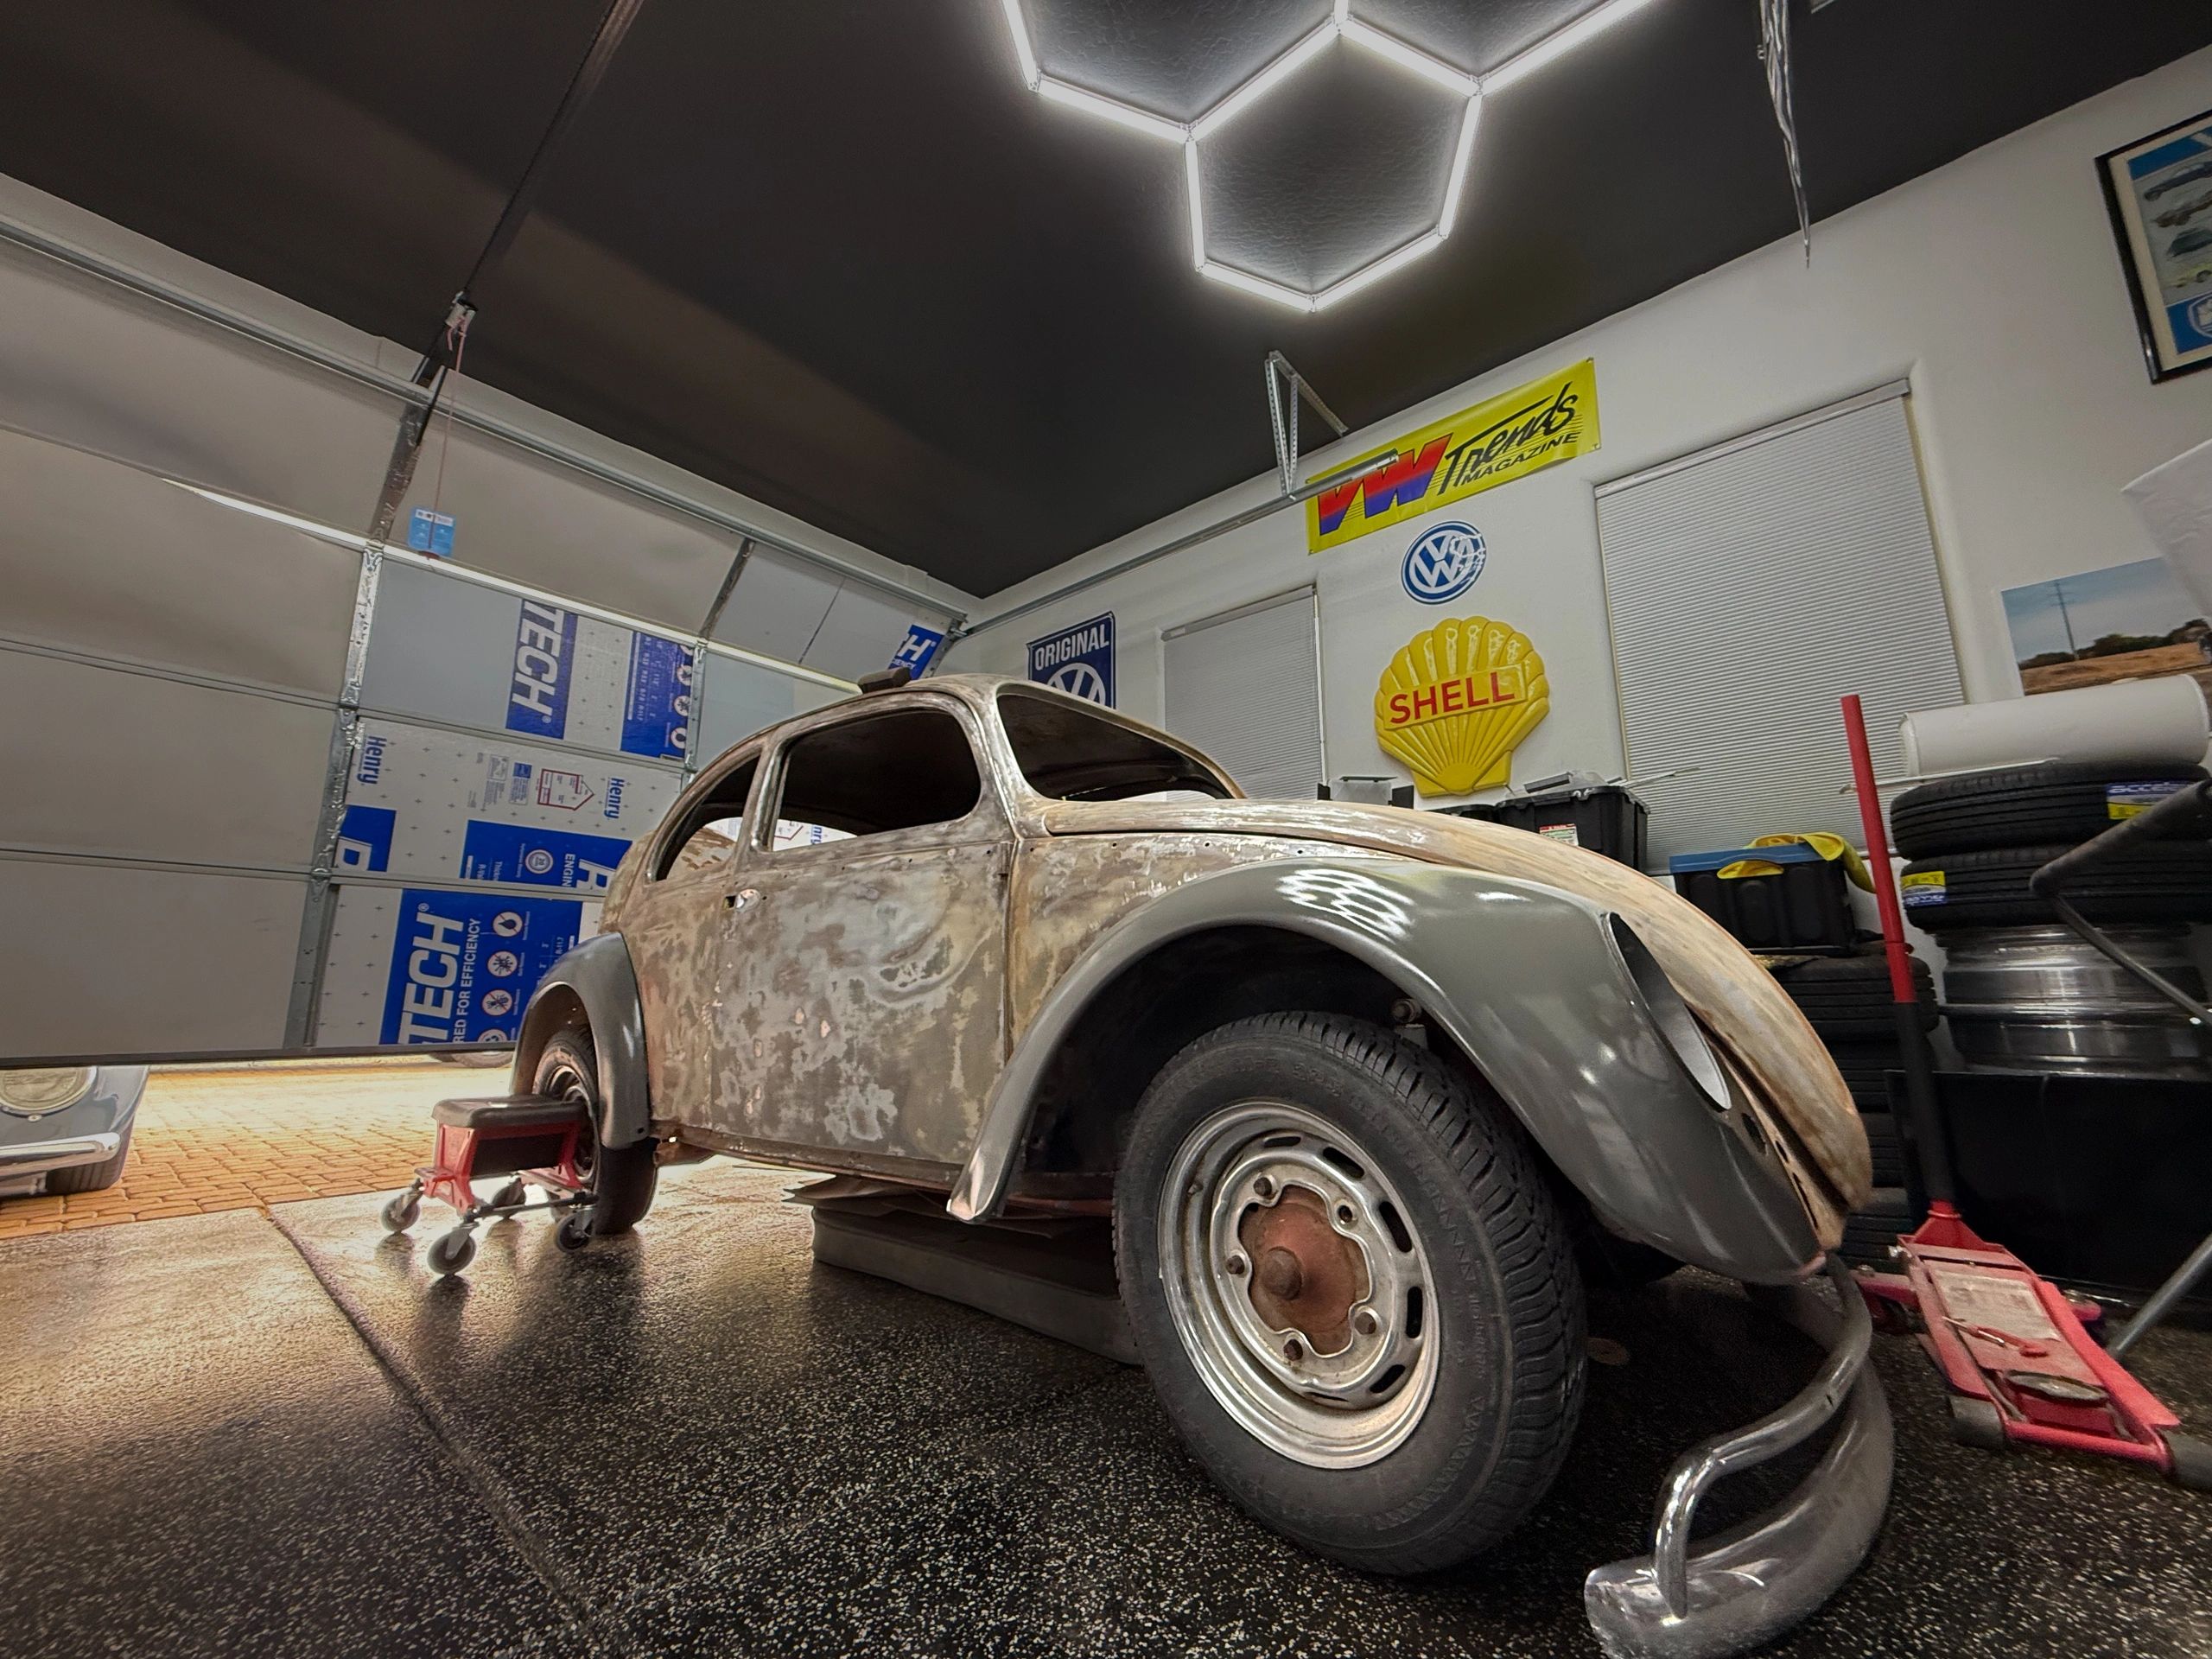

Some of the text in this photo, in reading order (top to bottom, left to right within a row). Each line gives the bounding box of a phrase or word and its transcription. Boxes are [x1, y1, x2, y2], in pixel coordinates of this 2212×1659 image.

[1318, 380, 1579, 537] VW Trends
[1461, 432, 1579, 486] MAGAZINE
[1034, 623, 1110, 671] ORIGINAL
[1389, 671, 1516, 725] SHELL
[357, 735, 387, 785] Henry
[604, 778, 625, 819] Henry
[461, 918, 481, 988] EFFICIENCY
[456, 991, 471, 1015] FOR
